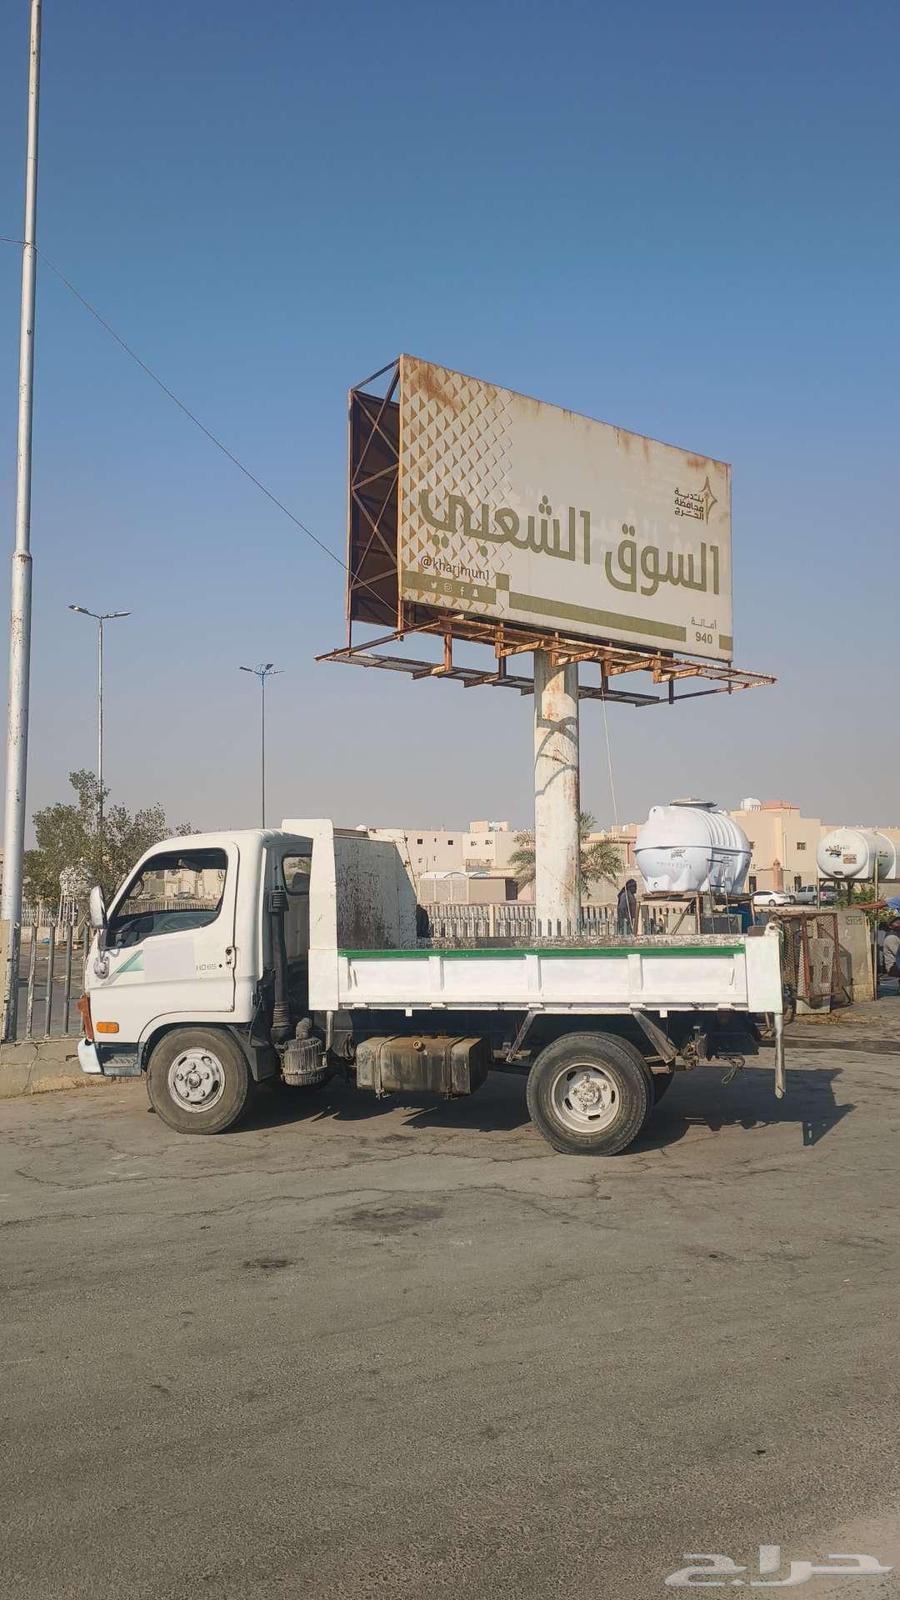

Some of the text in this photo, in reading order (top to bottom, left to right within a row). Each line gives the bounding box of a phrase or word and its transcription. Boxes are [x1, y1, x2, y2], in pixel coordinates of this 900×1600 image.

[674, 497, 704, 513] محافظة
[419, 488, 720, 597] السوق الشعبي
[695, 631, 713, 644] 940
